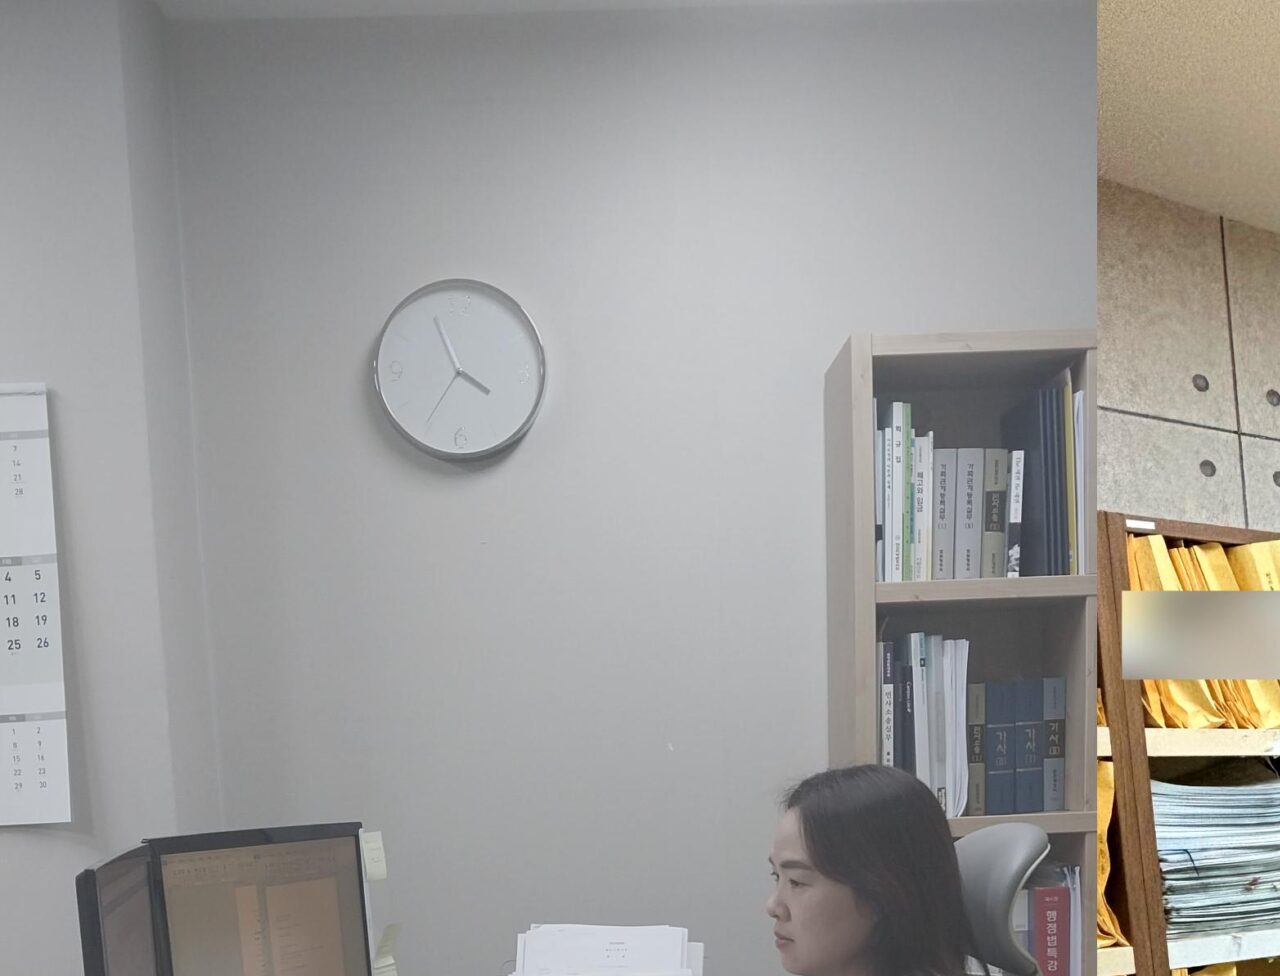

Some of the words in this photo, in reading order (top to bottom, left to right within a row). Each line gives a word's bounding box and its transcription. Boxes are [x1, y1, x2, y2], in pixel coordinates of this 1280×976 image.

[4, 571, 12, 582] 4
[34, 569, 41, 581] 5
[3, 594, 16, 605] 11
[33, 592, 46, 603] 12
[5, 616, 19, 627] 18
[35, 614, 47, 626] 19
[7, 639, 21, 650] 25
[36, 637, 49, 648] 26
[885, 691, 893, 741] 민사소송실무
[1048, 721, 1060, 745] 가사
[1046, 911, 1058, 972] 행정법특강
